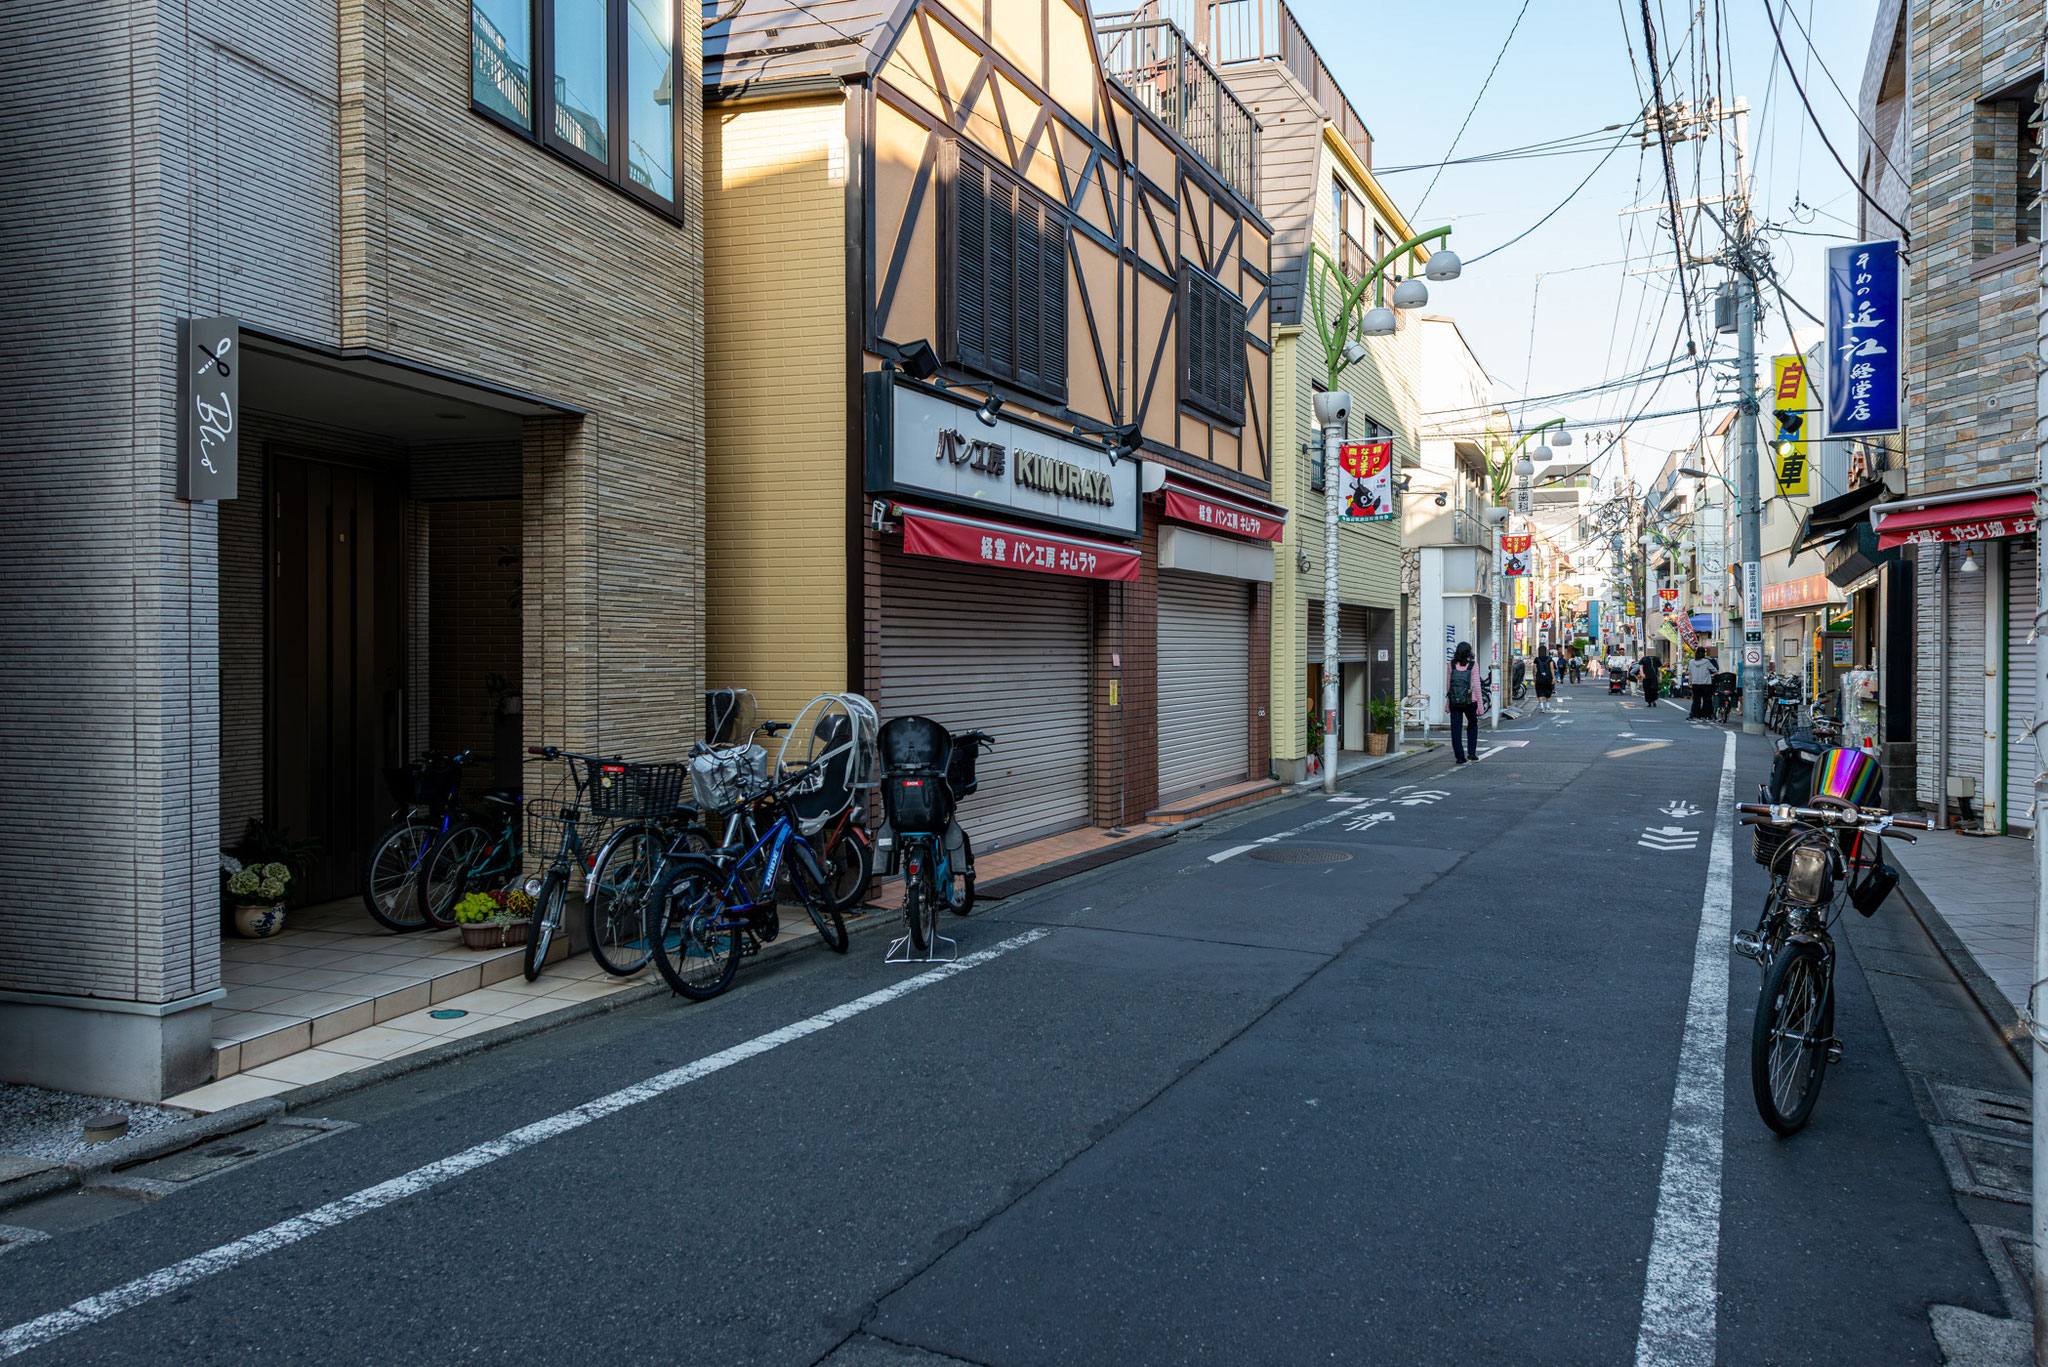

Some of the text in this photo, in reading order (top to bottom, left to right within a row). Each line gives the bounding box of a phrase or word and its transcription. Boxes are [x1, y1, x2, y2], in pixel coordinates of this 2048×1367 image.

[936, 427, 1115, 507] パン工房 KIMURAYA
[1199, 504, 1213, 524] 経堂
[1215, 509, 1239, 531] パン工房
[980, 535, 1097, 574] 経堂 パン工房 キムラヤ
